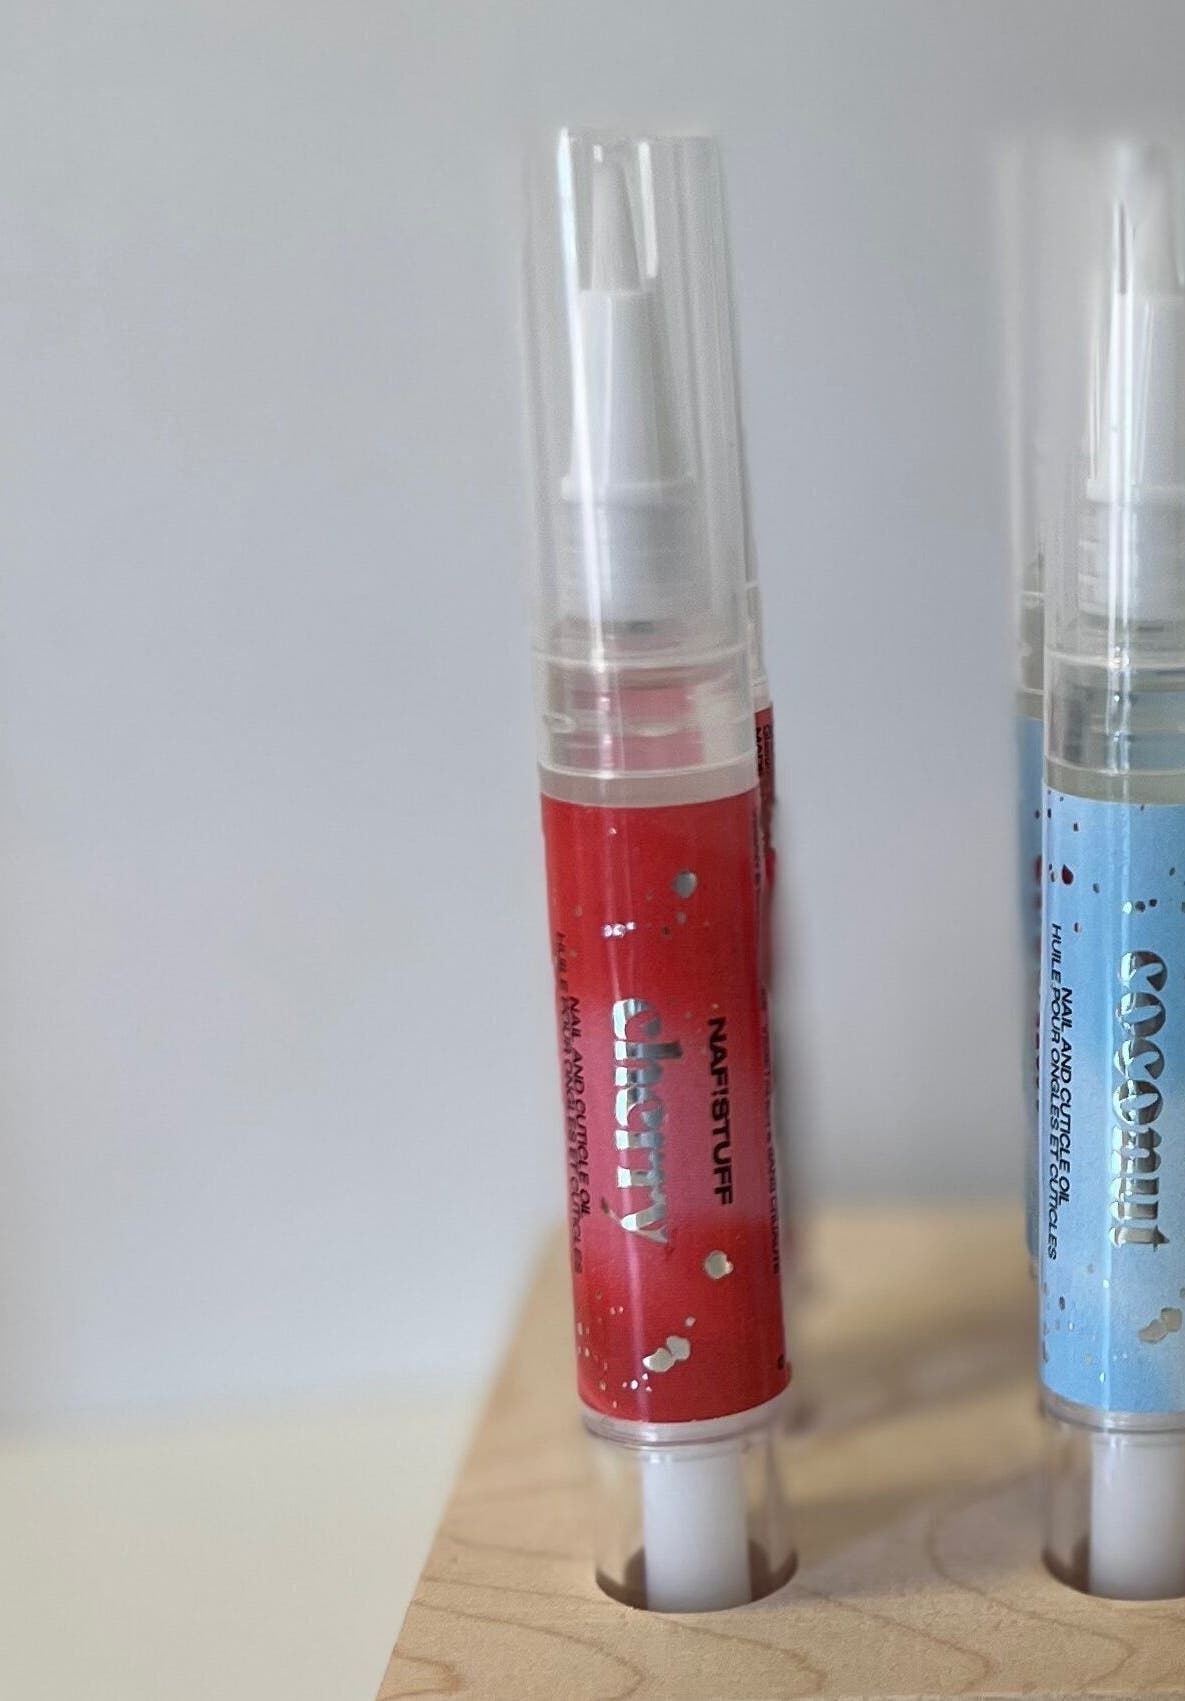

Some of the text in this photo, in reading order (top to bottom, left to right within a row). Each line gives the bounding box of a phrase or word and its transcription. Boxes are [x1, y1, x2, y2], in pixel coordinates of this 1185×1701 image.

[568, 996, 590, 1216] NAIL AND CUTICLE OIL
[601, 998, 683, 1243] cherry
[706, 1017, 733, 1205] NAF!STUFF
[1048, 924, 1062, 1260] HUILE POUR ONGLES ET CUTICLES
[1058, 988, 1073, 1206] NAIL AND CUTICLE OIL
[1108, 950, 1170, 1252] coconut
